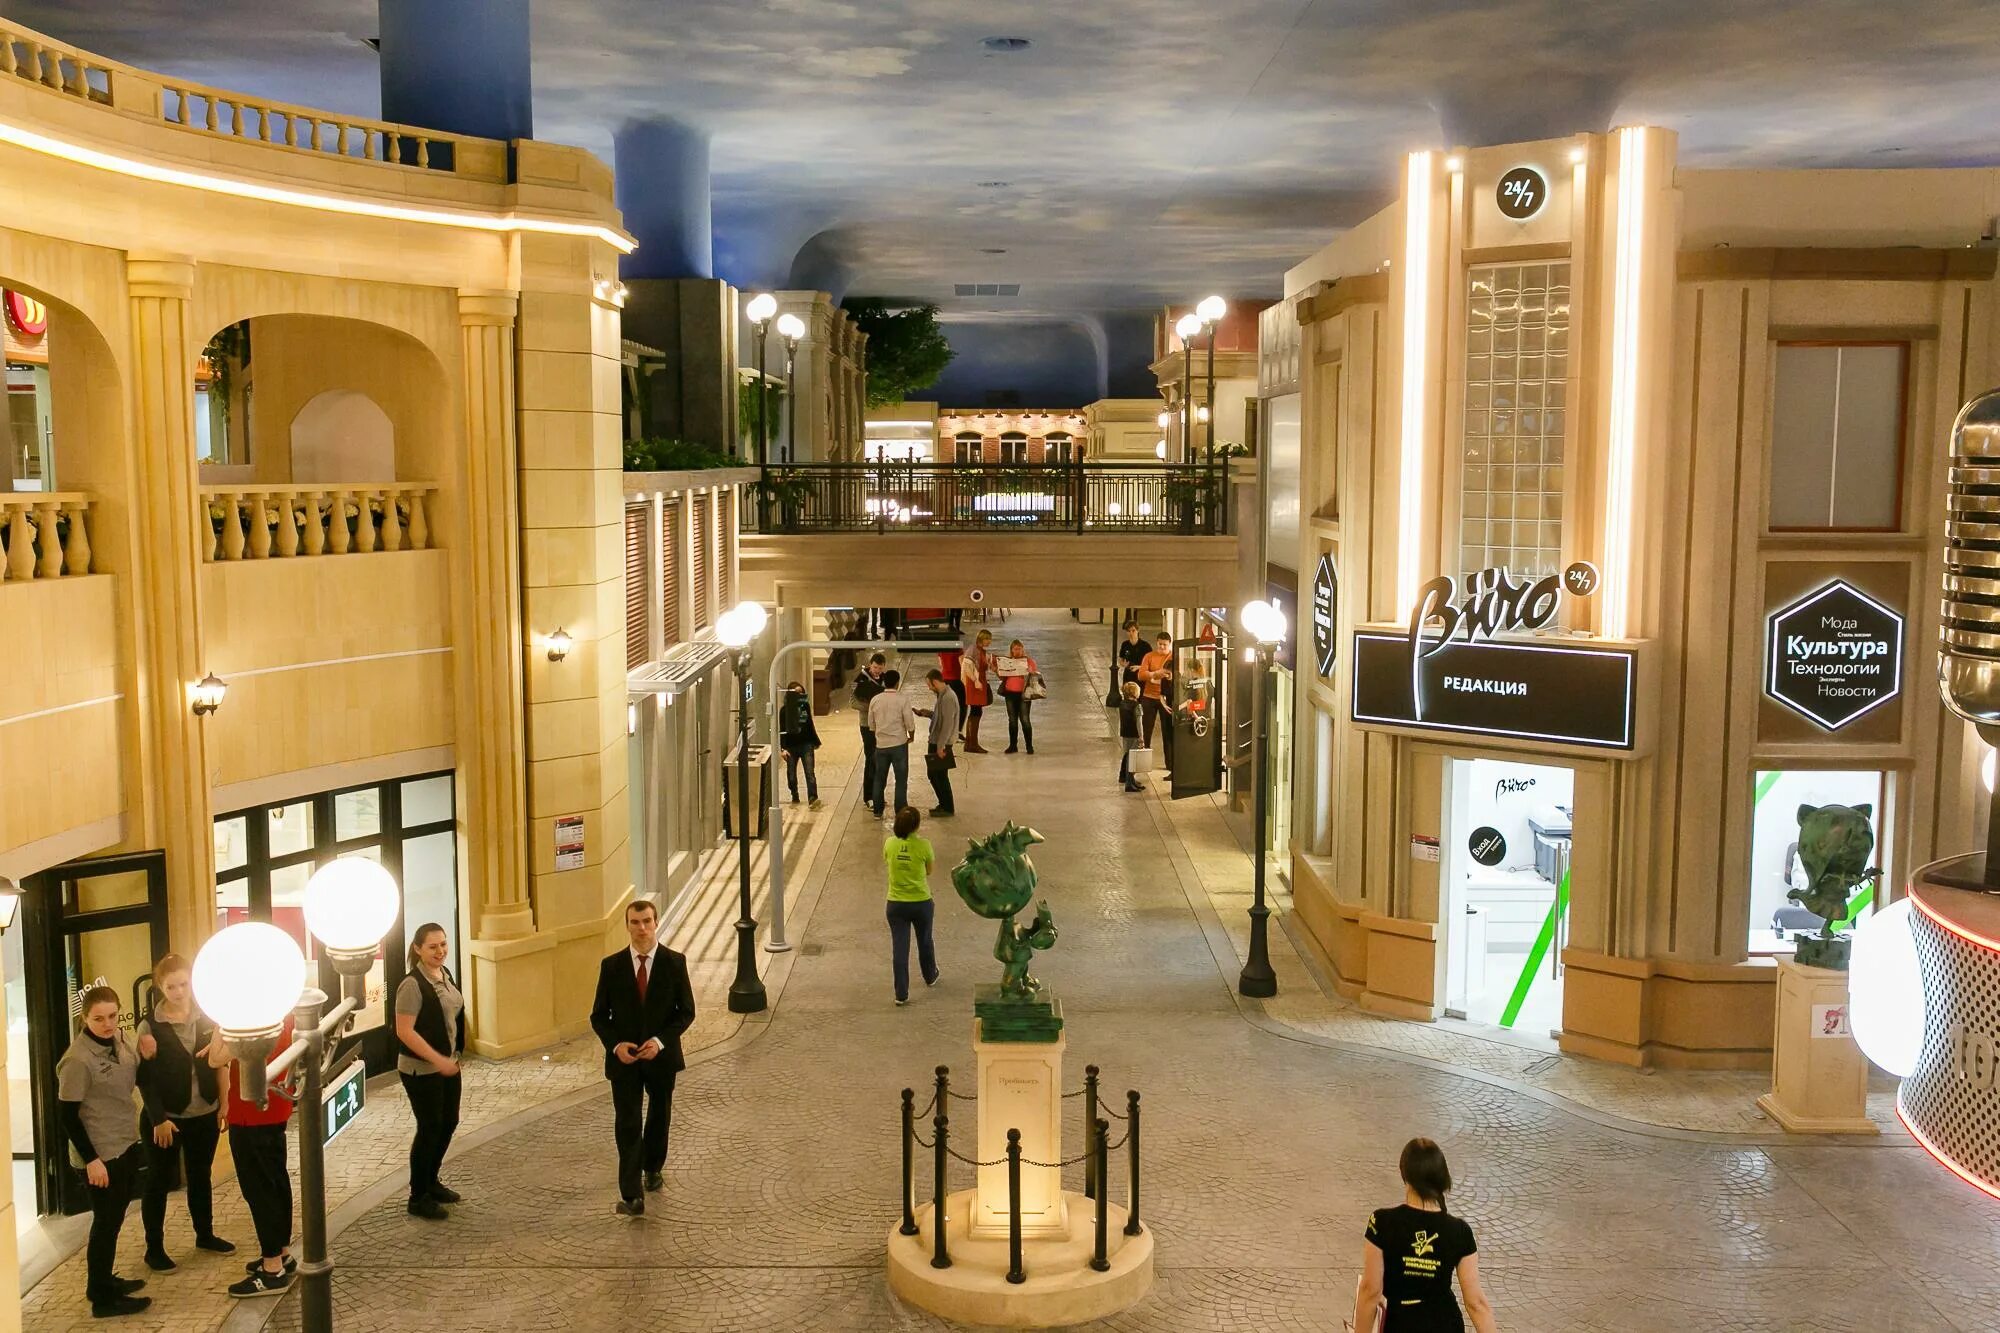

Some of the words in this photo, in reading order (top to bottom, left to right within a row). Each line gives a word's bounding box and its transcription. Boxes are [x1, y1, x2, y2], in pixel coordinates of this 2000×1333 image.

[1504, 179, 1534, 207] 24/7
[1569, 570, 1590, 590] 24/7
[1821, 616, 1858, 629] Мода
[1787, 635, 1888, 660] Культура
[1787, 660, 1880, 675] Технологии
[1443, 676, 1527, 695] РЕДАКЦИЯ
[1818, 685, 1876, 697] Новости
[1472, 838, 1491, 857] Вход
